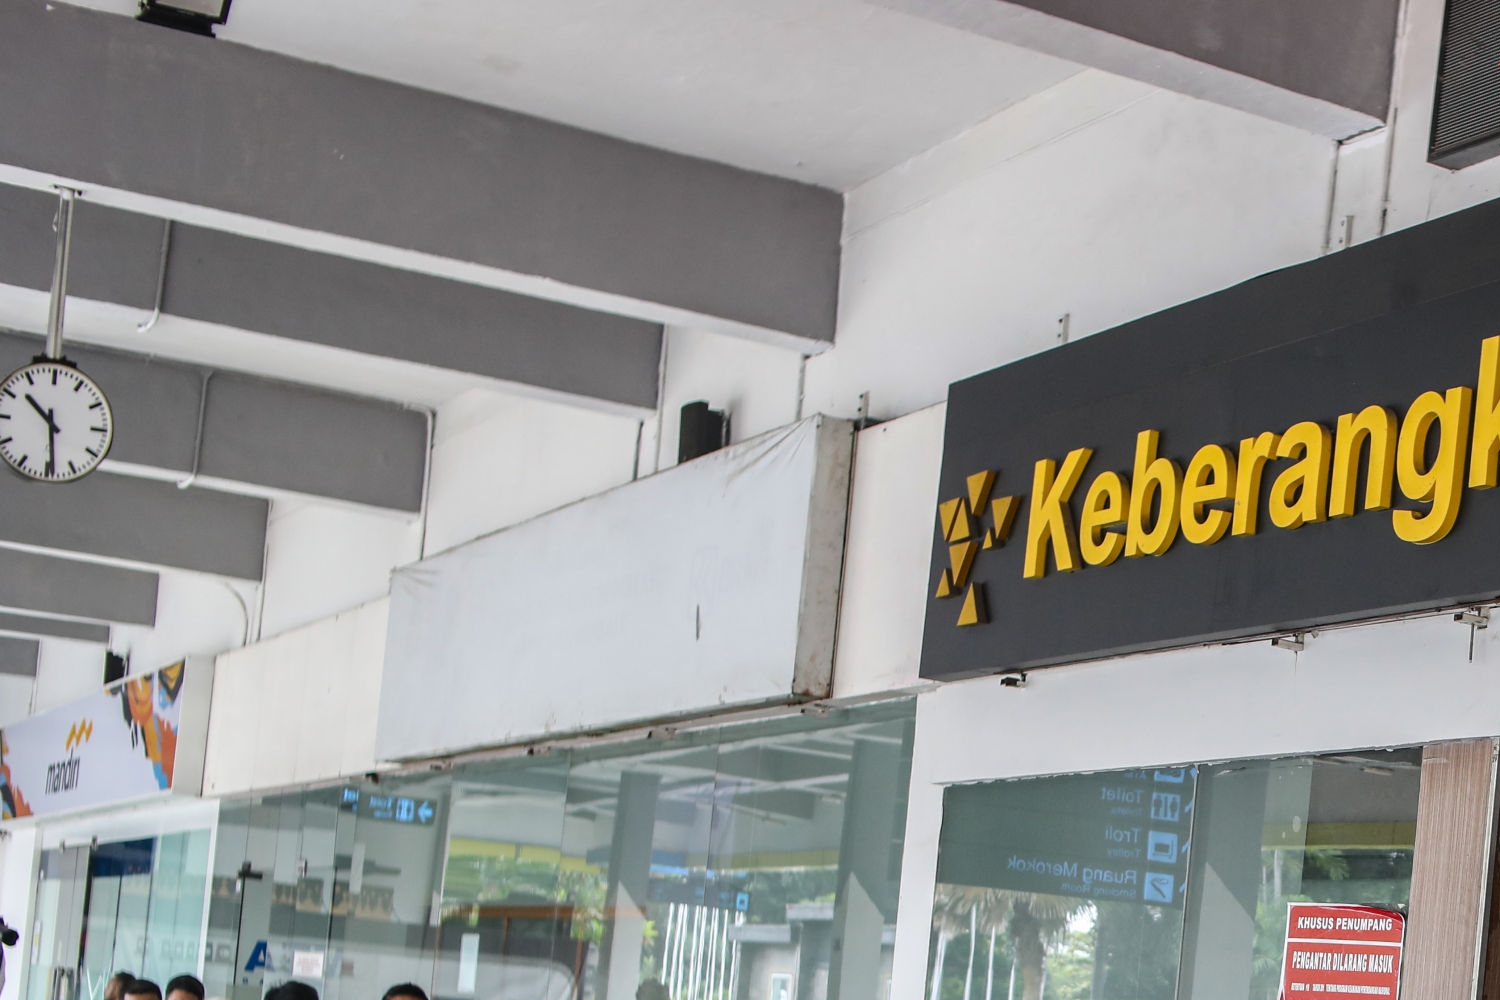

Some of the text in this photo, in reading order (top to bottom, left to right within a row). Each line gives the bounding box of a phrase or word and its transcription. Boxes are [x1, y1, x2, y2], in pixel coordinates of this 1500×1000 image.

[45, 747, 80, 795] mandiri
[1297, 916, 1393, 931] KHUSUS PENUMPANG
[1292, 951, 1394, 974] PENGANTAR DILARANG MASUK
